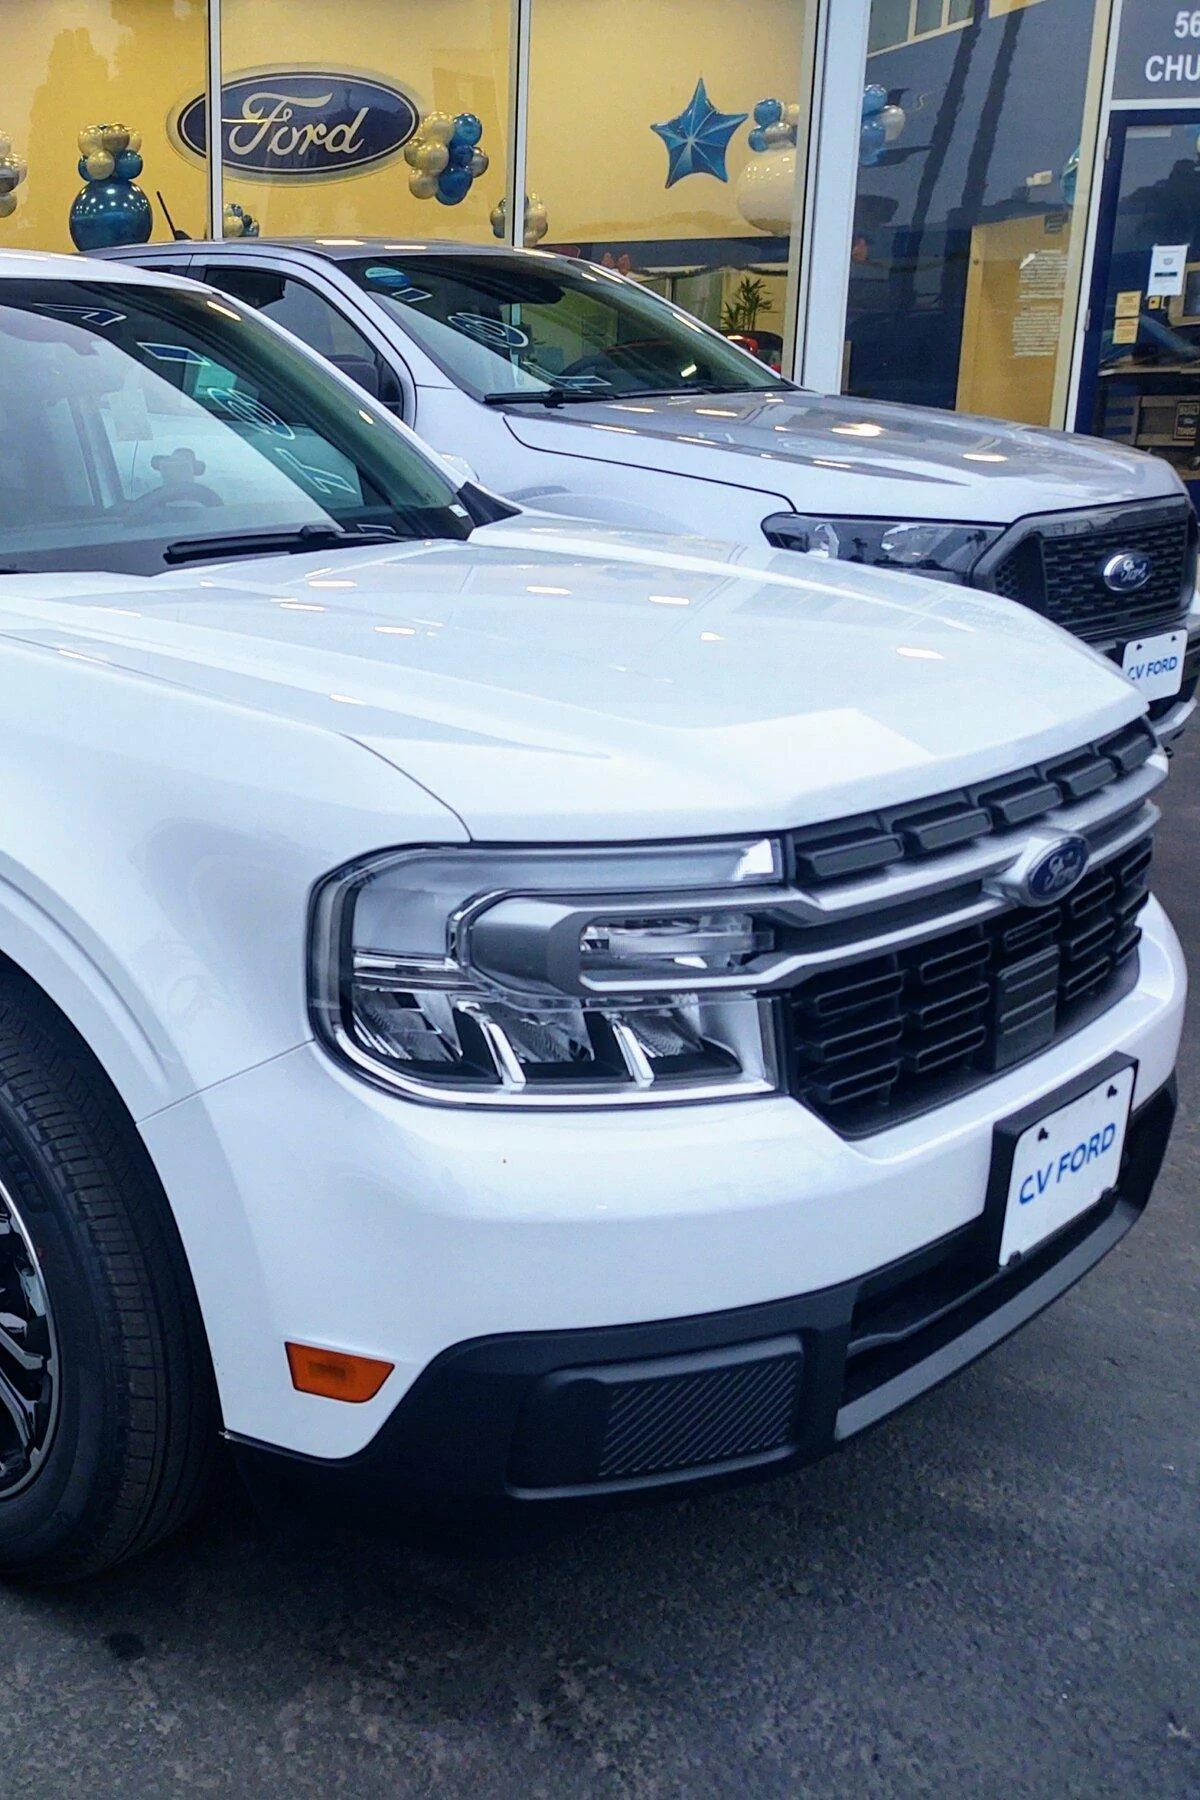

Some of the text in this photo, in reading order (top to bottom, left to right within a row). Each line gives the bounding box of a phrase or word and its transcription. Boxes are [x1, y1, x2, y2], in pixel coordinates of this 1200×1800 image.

[1145, 54, 1200, 82] CHU
[228, 92, 370, 157] Ford
[1127, 656, 1178, 680] CV FORD
[1017, 1122, 1117, 1206] CV FORD
